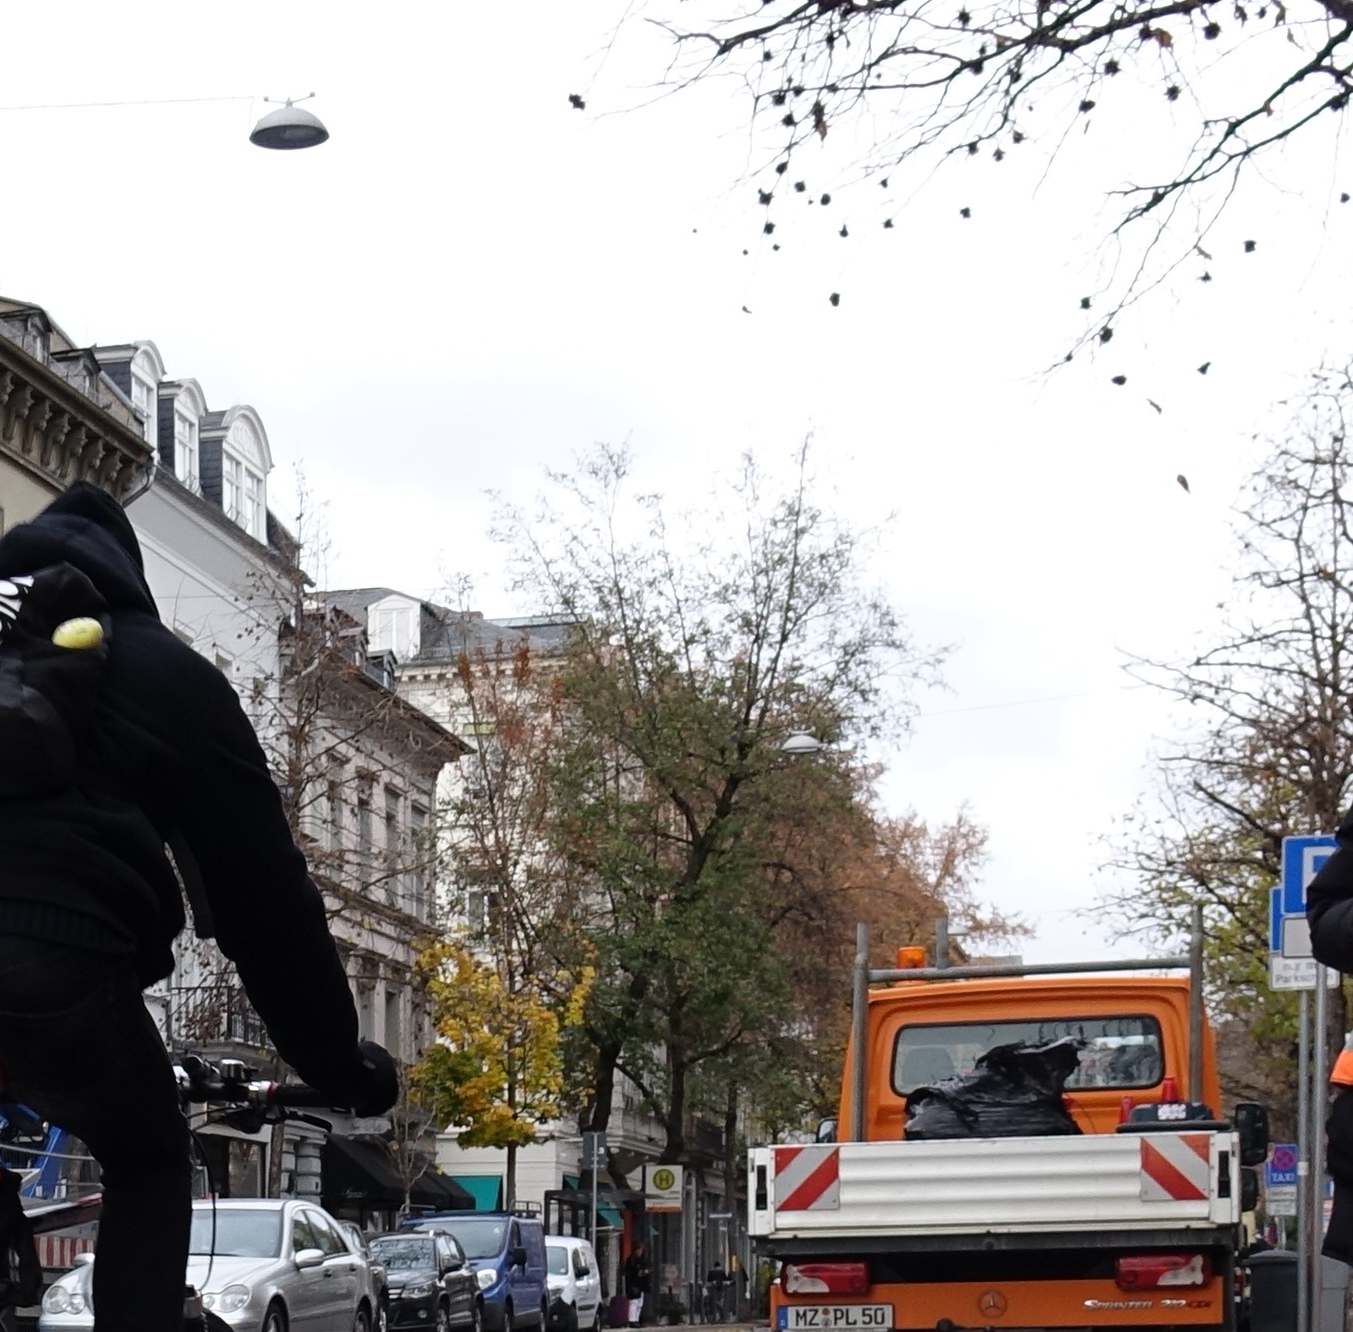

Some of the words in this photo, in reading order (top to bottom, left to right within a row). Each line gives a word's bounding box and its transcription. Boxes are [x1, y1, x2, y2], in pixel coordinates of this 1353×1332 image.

[795, 1308, 820, 1327] MZ
[832, 1308, 857, 1326] PL
[861, 1307, 885, 1326] 50
